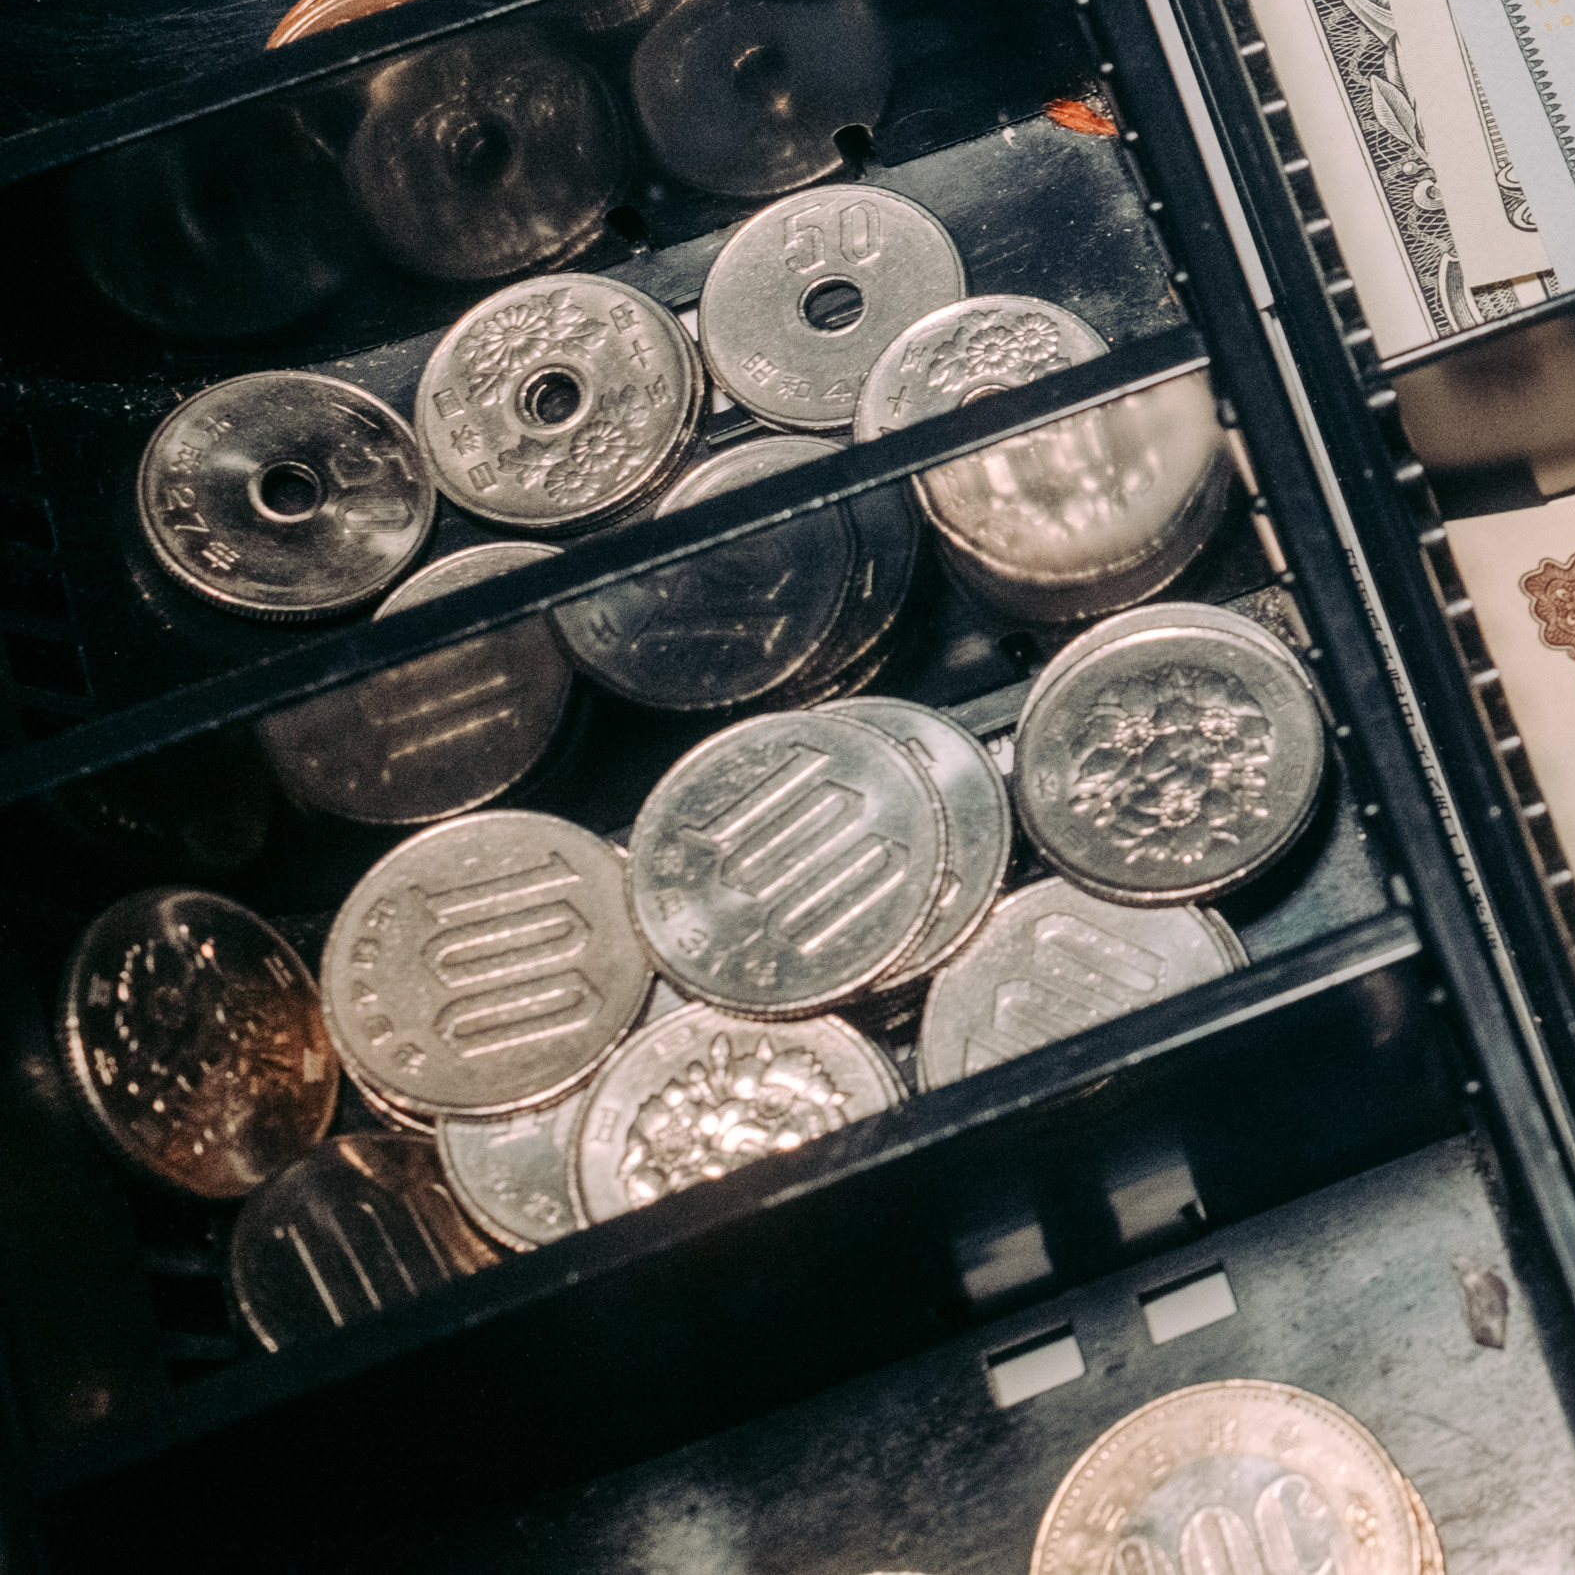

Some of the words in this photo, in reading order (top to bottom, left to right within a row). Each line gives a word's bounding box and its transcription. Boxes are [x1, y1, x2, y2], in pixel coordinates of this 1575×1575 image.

[783, 198, 884, 274] 50
[328, 444, 417, 534] 50
[679, 740, 913, 955] 100
[408, 850, 605, 1059] 100
